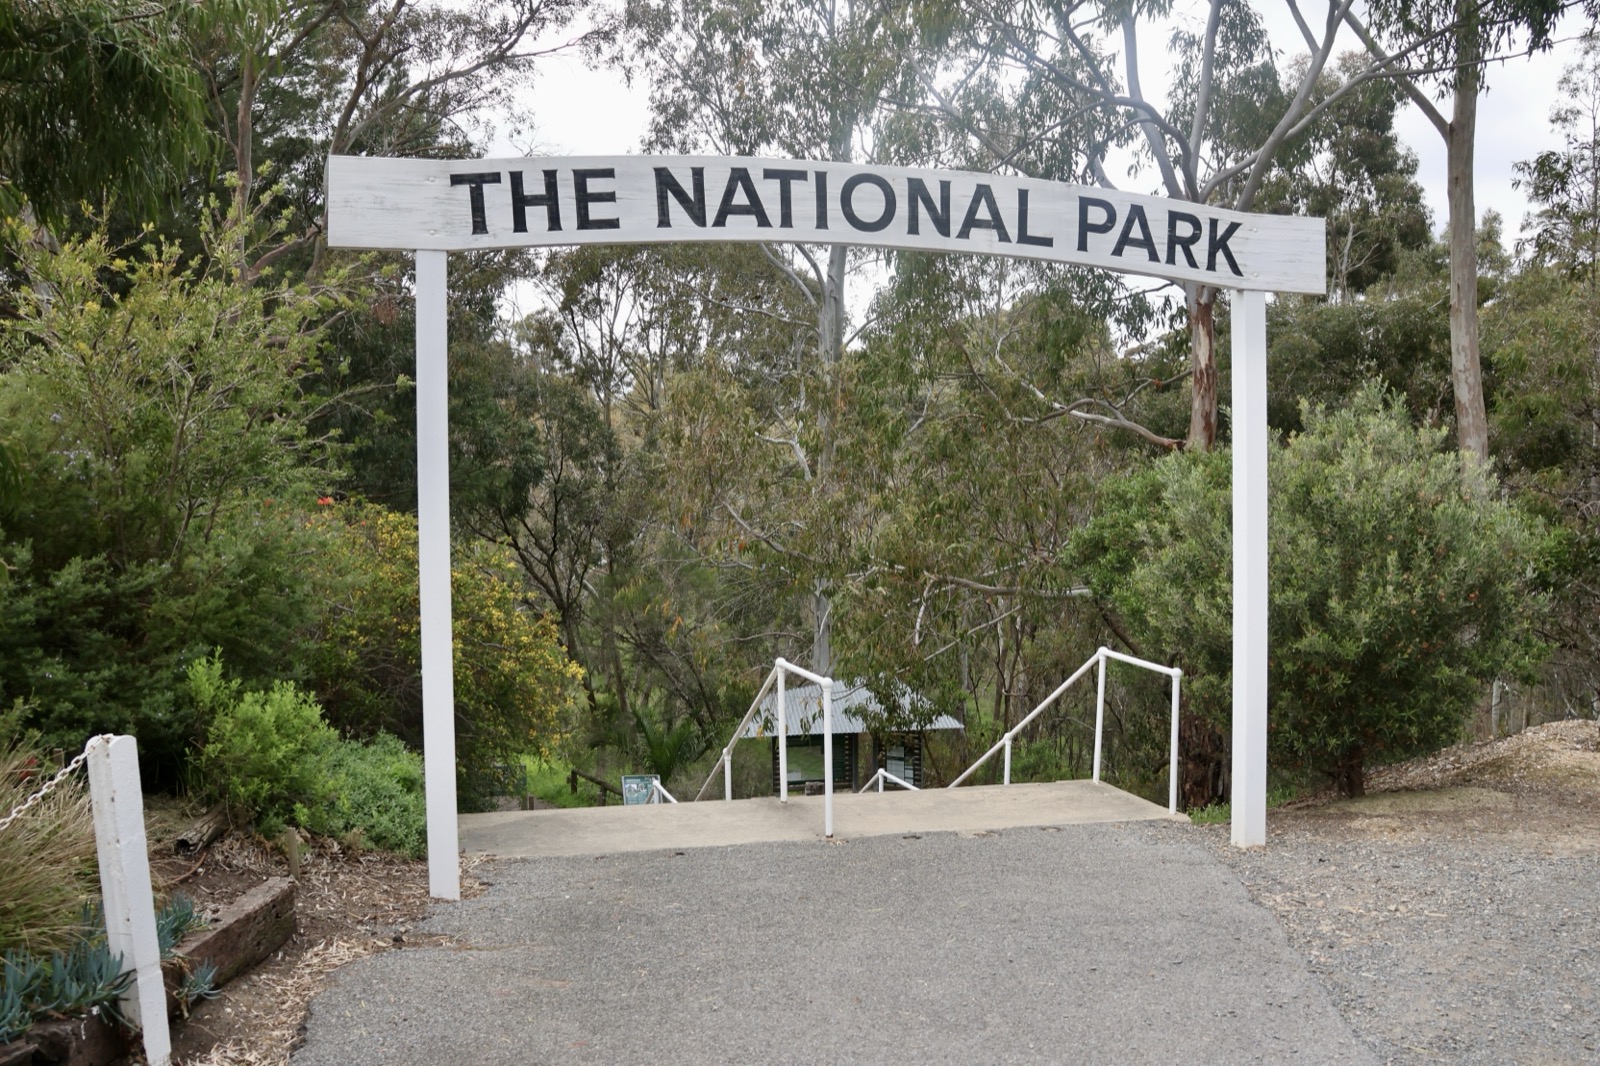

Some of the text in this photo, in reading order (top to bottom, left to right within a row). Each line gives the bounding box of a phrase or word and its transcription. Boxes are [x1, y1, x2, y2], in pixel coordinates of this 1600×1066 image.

[450, 166, 1244, 277] THE NATIONAL PARK
